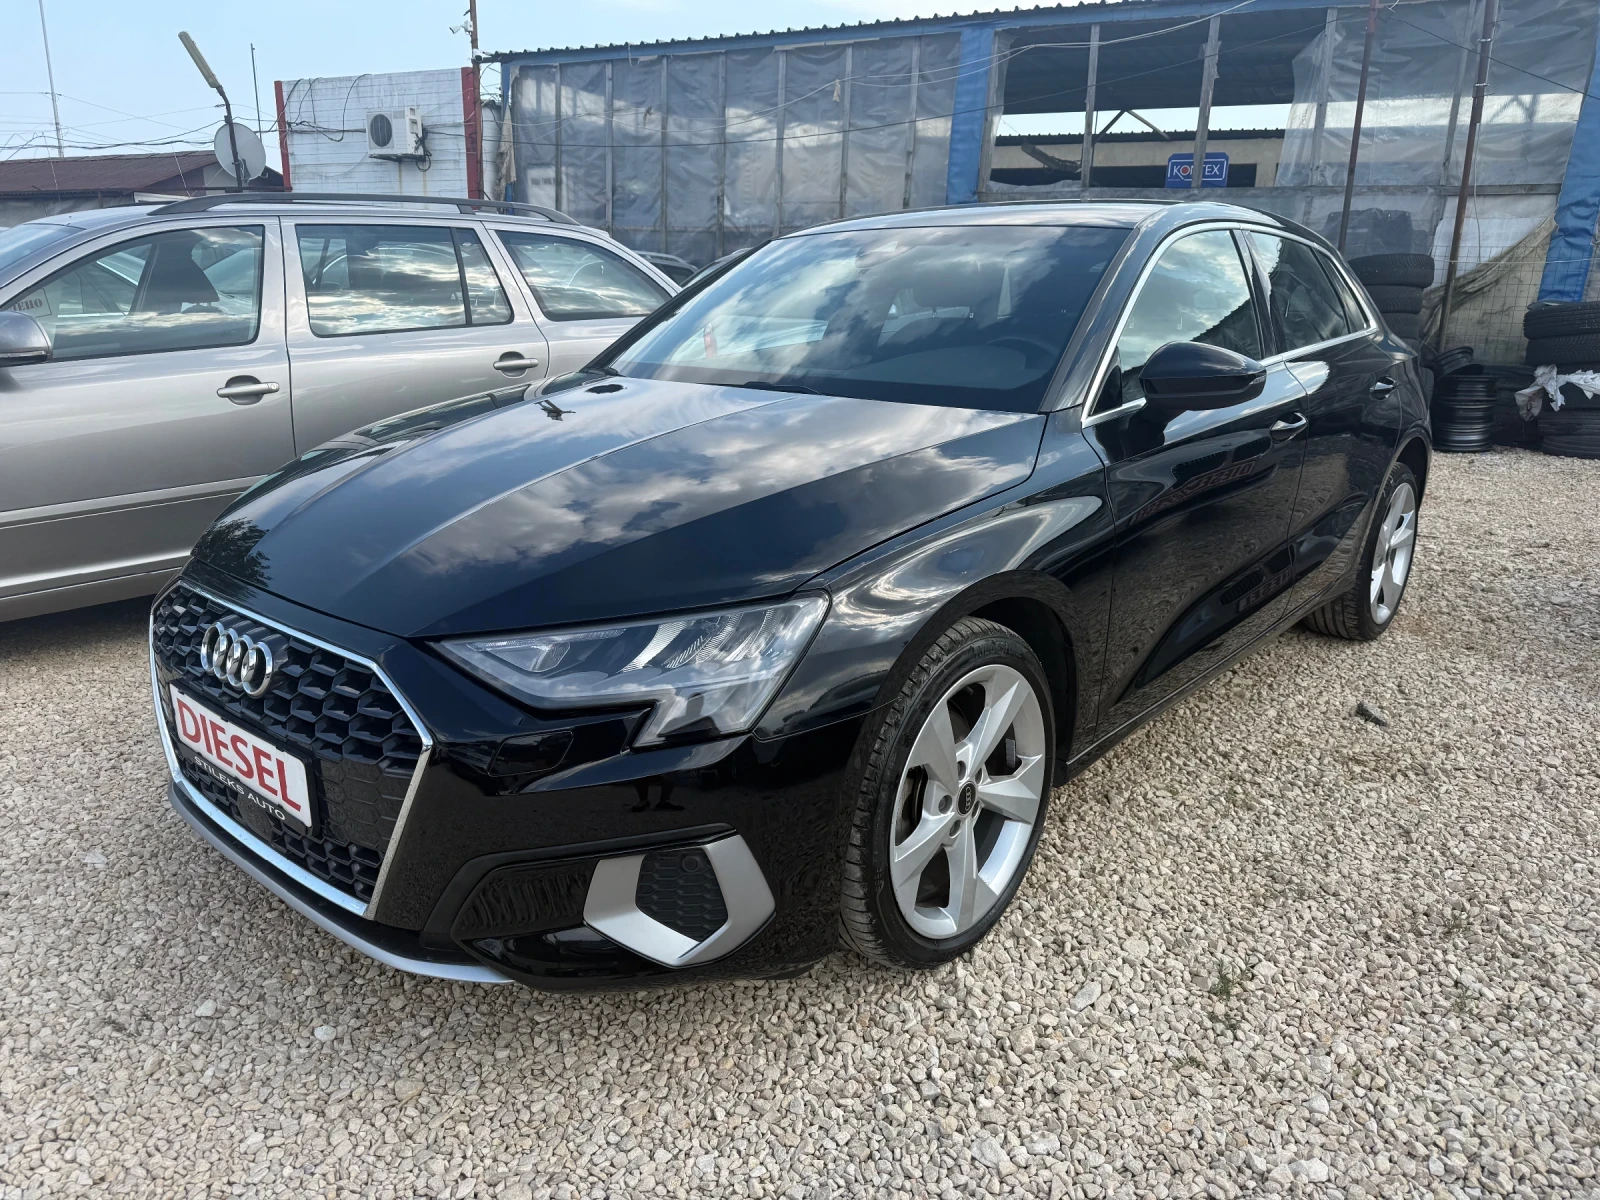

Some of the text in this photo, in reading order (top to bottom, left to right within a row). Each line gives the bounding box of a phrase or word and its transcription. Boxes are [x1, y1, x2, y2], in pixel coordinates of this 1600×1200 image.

[1173, 164, 1220, 176] KOEX
[176, 697, 302, 812] DIESEL
[194, 755, 286, 821] STILEKS AUTO
